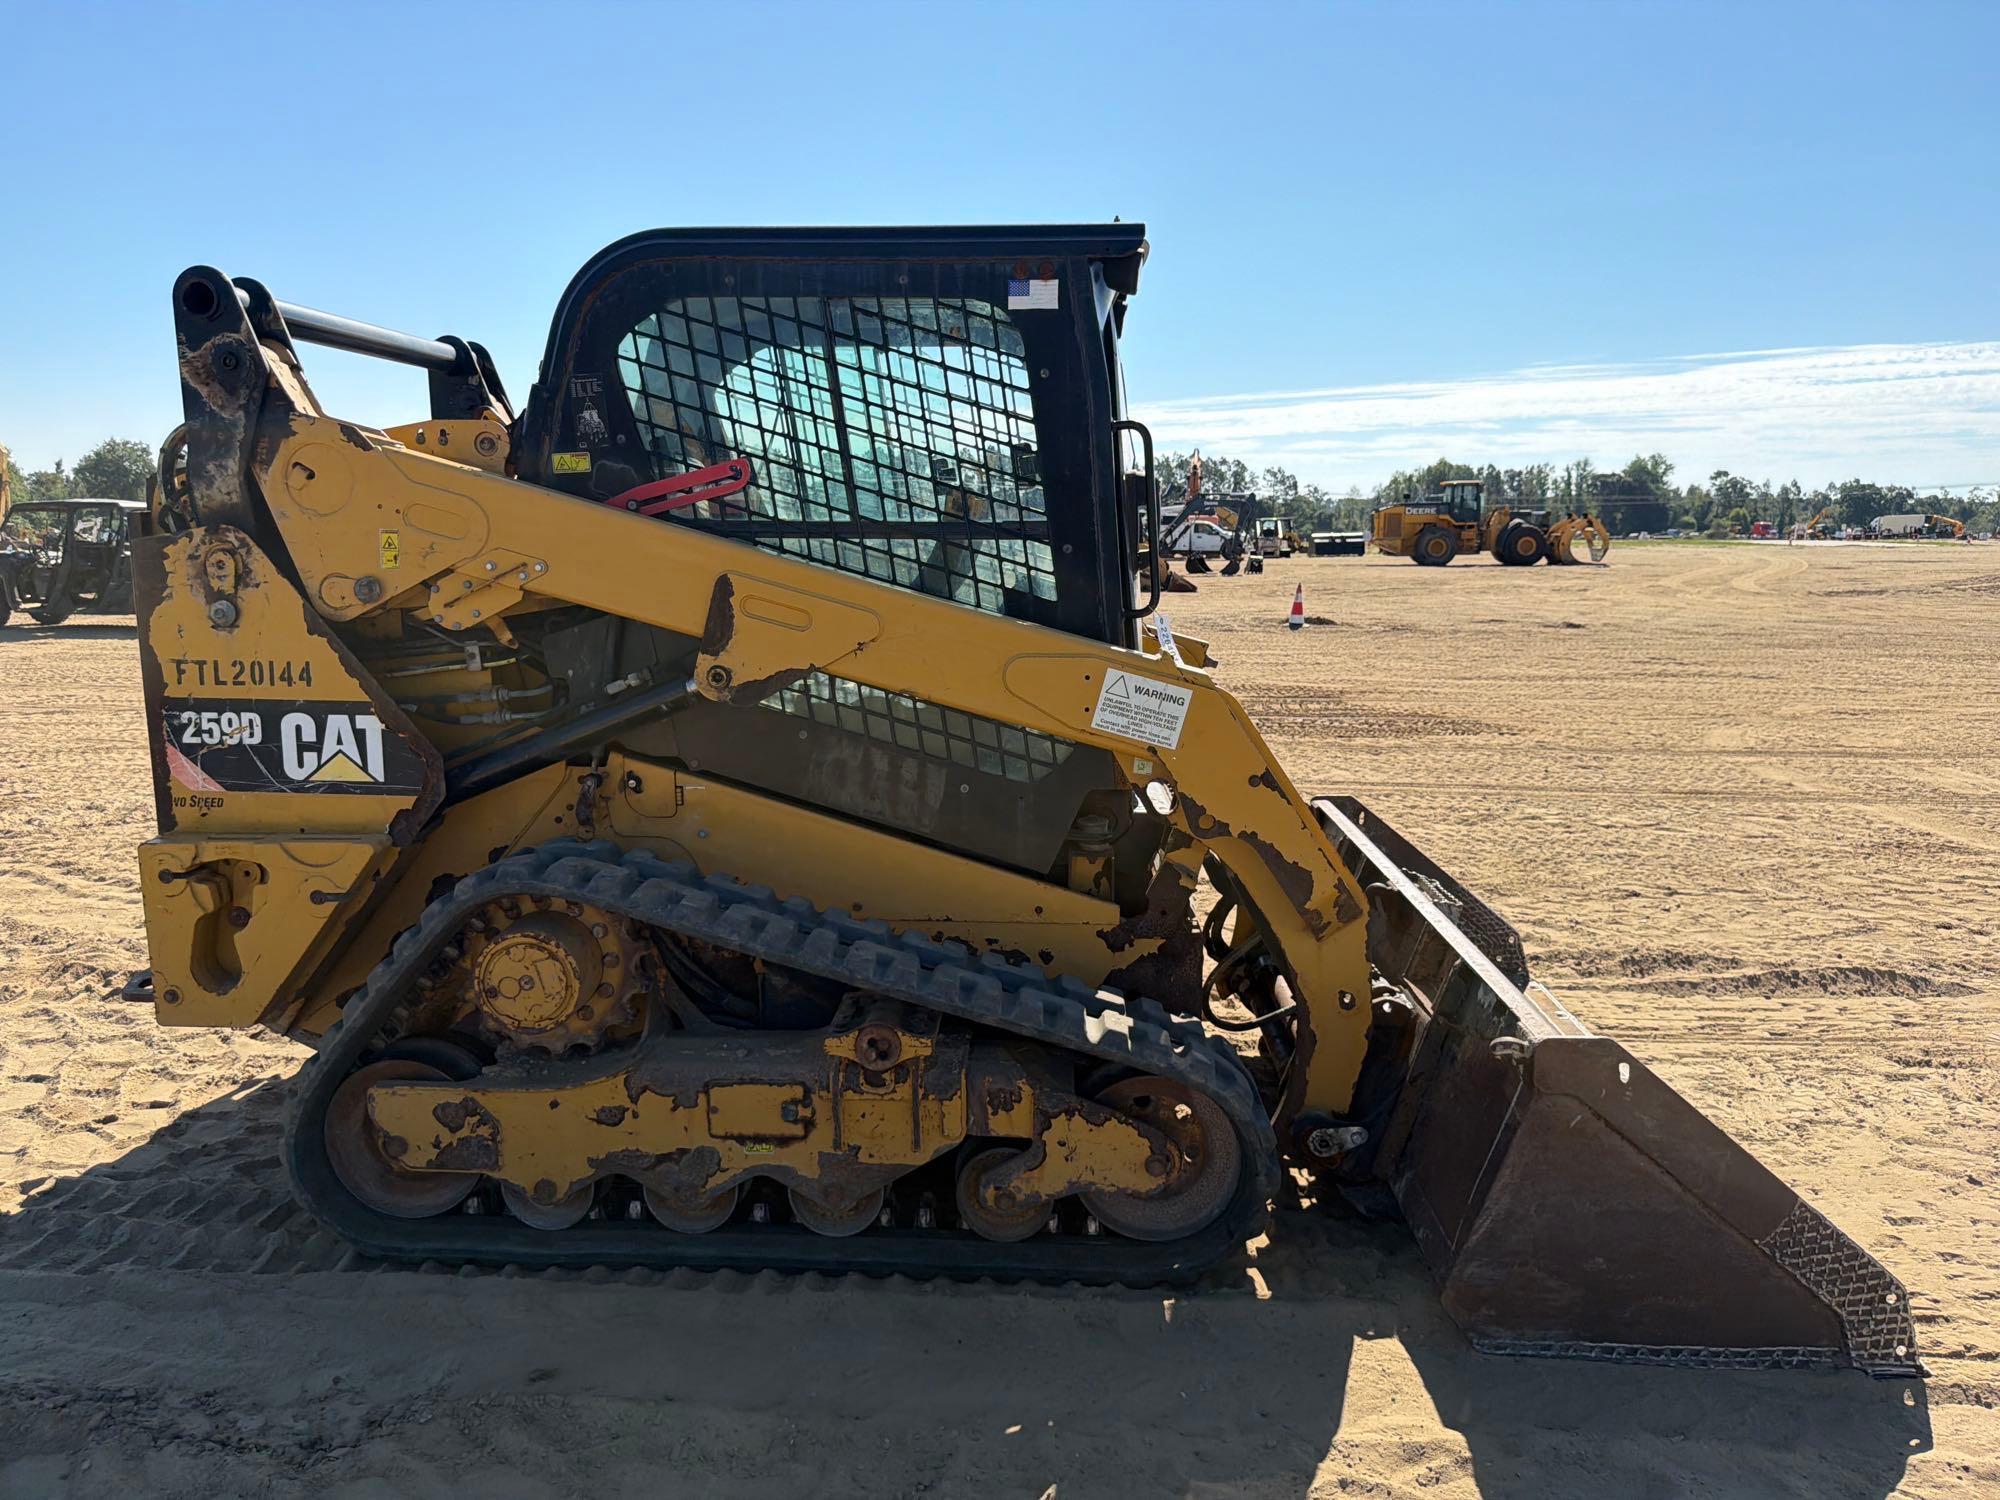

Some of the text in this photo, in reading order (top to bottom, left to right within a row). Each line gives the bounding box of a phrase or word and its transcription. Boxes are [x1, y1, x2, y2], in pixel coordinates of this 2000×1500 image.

[1405, 507, 1437, 515] DEERE
[176, 659, 313, 688] FTL20144
[1132, 684, 1185, 706] WARNING
[1101, 701, 1133, 714] EQUIPMENT
[1133, 710, 1152, 719] WITHIN
[1163, 718, 1177, 726] FEET
[1103, 696, 1133, 708] UNLAWFUL
[1141, 706, 1166, 717] OPERATE
[1108, 709, 1138, 721] OVERHEAD
[182, 711, 262, 745] 259D
[1099, 718, 1120, 727] Contact
[1131, 726, 1147, 735] power
[1126, 720, 1143, 728] LINES
[281, 712, 386, 782] CAT
